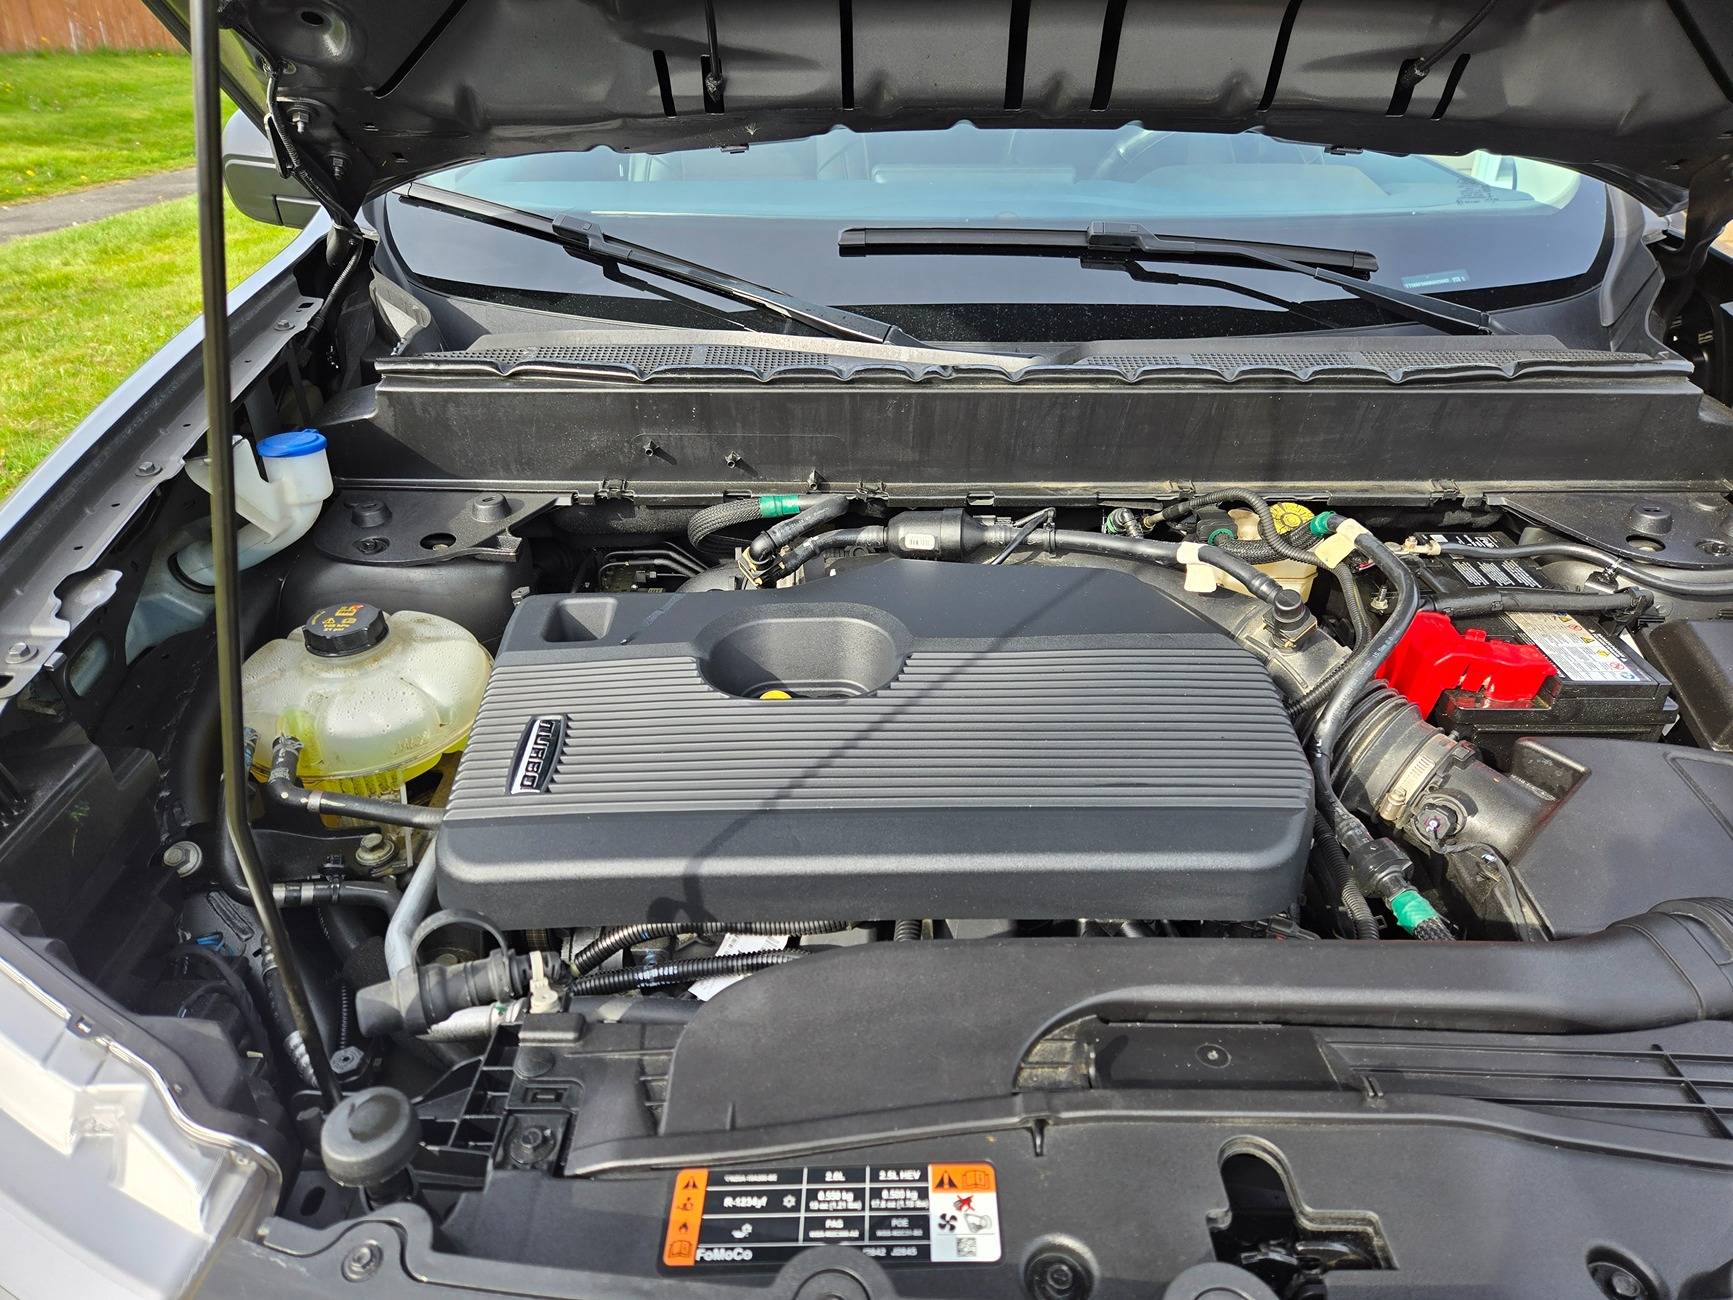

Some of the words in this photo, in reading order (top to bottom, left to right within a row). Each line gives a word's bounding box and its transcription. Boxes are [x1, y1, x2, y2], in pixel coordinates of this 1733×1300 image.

[520, 720, 555, 790] TURBO
[879, 1170, 899, 1181] 2.5L
[900, 1169, 921, 1180] HEV
[842, 1190, 854, 1202] kg
[906, 1188, 918, 1201] kg
[723, 1196, 767, 1208] R-1234yf
[825, 1218, 844, 1228] PAG
[695, 1248, 753, 1261] FoMoCo
